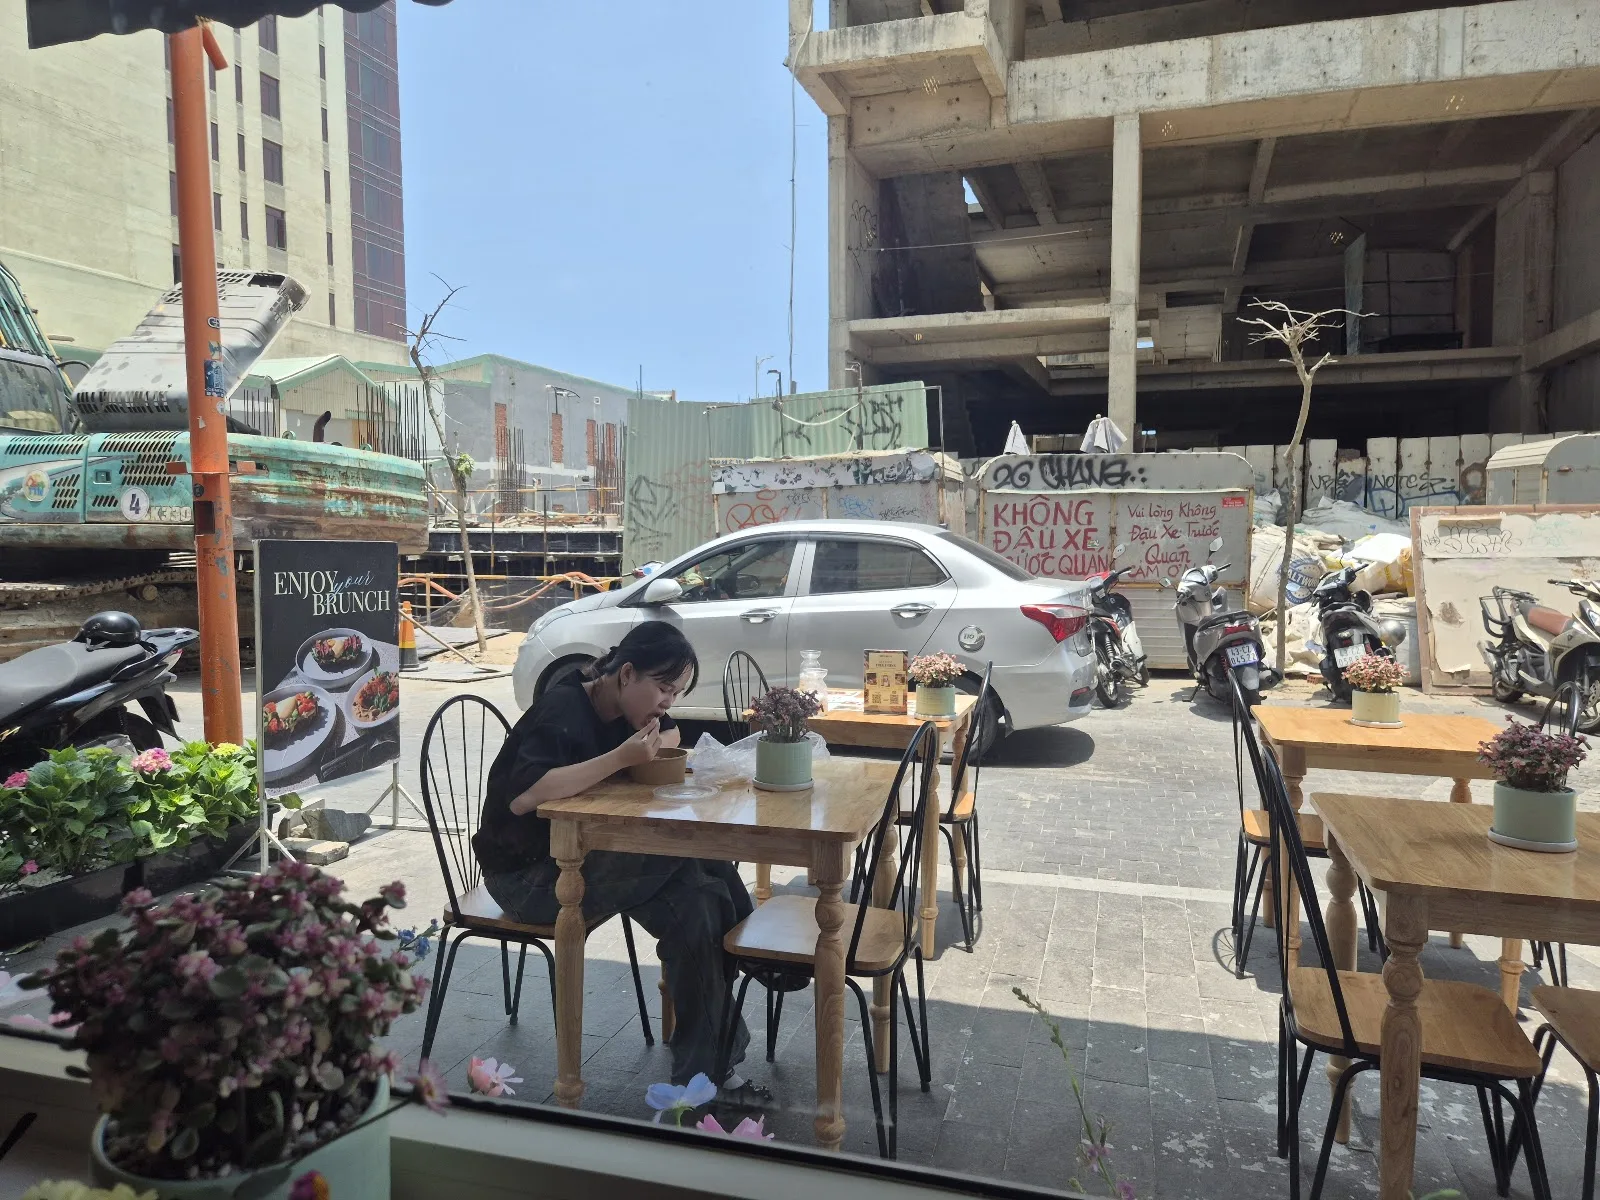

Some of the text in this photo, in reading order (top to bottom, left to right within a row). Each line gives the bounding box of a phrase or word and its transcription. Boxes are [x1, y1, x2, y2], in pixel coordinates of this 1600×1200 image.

[130, 494, 141, 514] 4
[993, 495, 1094, 527] KHÔNG
[1127, 503, 1144, 518] Vui
[1149, 503, 1173, 522] lòng
[1179, 502, 1216, 520] Không
[993, 526, 1098, 553] ĐẬU XE
[1129, 524, 1157, 545] Đậu
[1161, 524, 1180, 539] Xe
[1058, 547, 1109, 576] QUÁN
[1145, 543, 1191, 565] Quán
[274, 570, 374, 605] ENJOY your
[312, 590, 390, 616] BRUNCH
